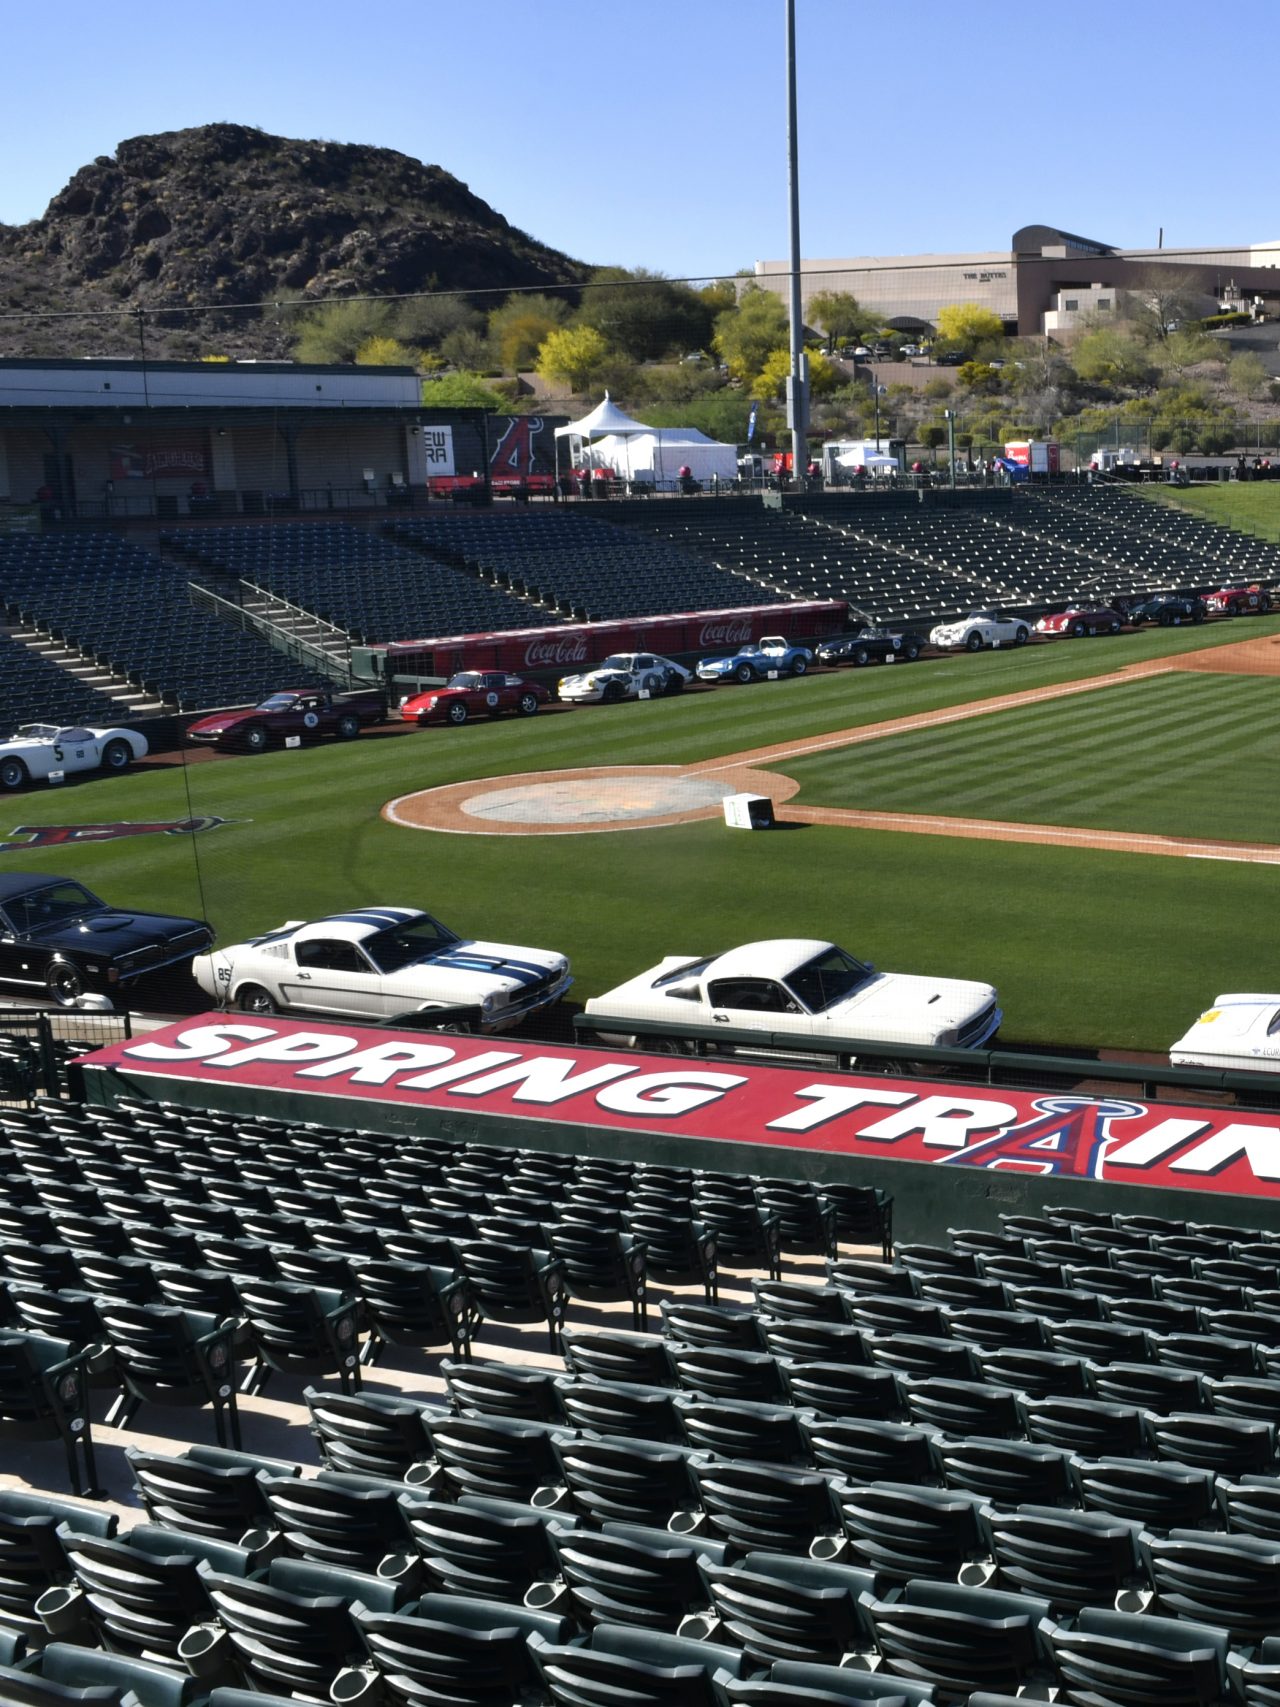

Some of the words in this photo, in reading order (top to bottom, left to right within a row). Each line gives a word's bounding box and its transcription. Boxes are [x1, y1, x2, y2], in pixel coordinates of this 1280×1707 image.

[54, 743, 64, 763] 5
[218, 967, 231, 981] 85
[123, 1024, 750, 1118] SPRING
